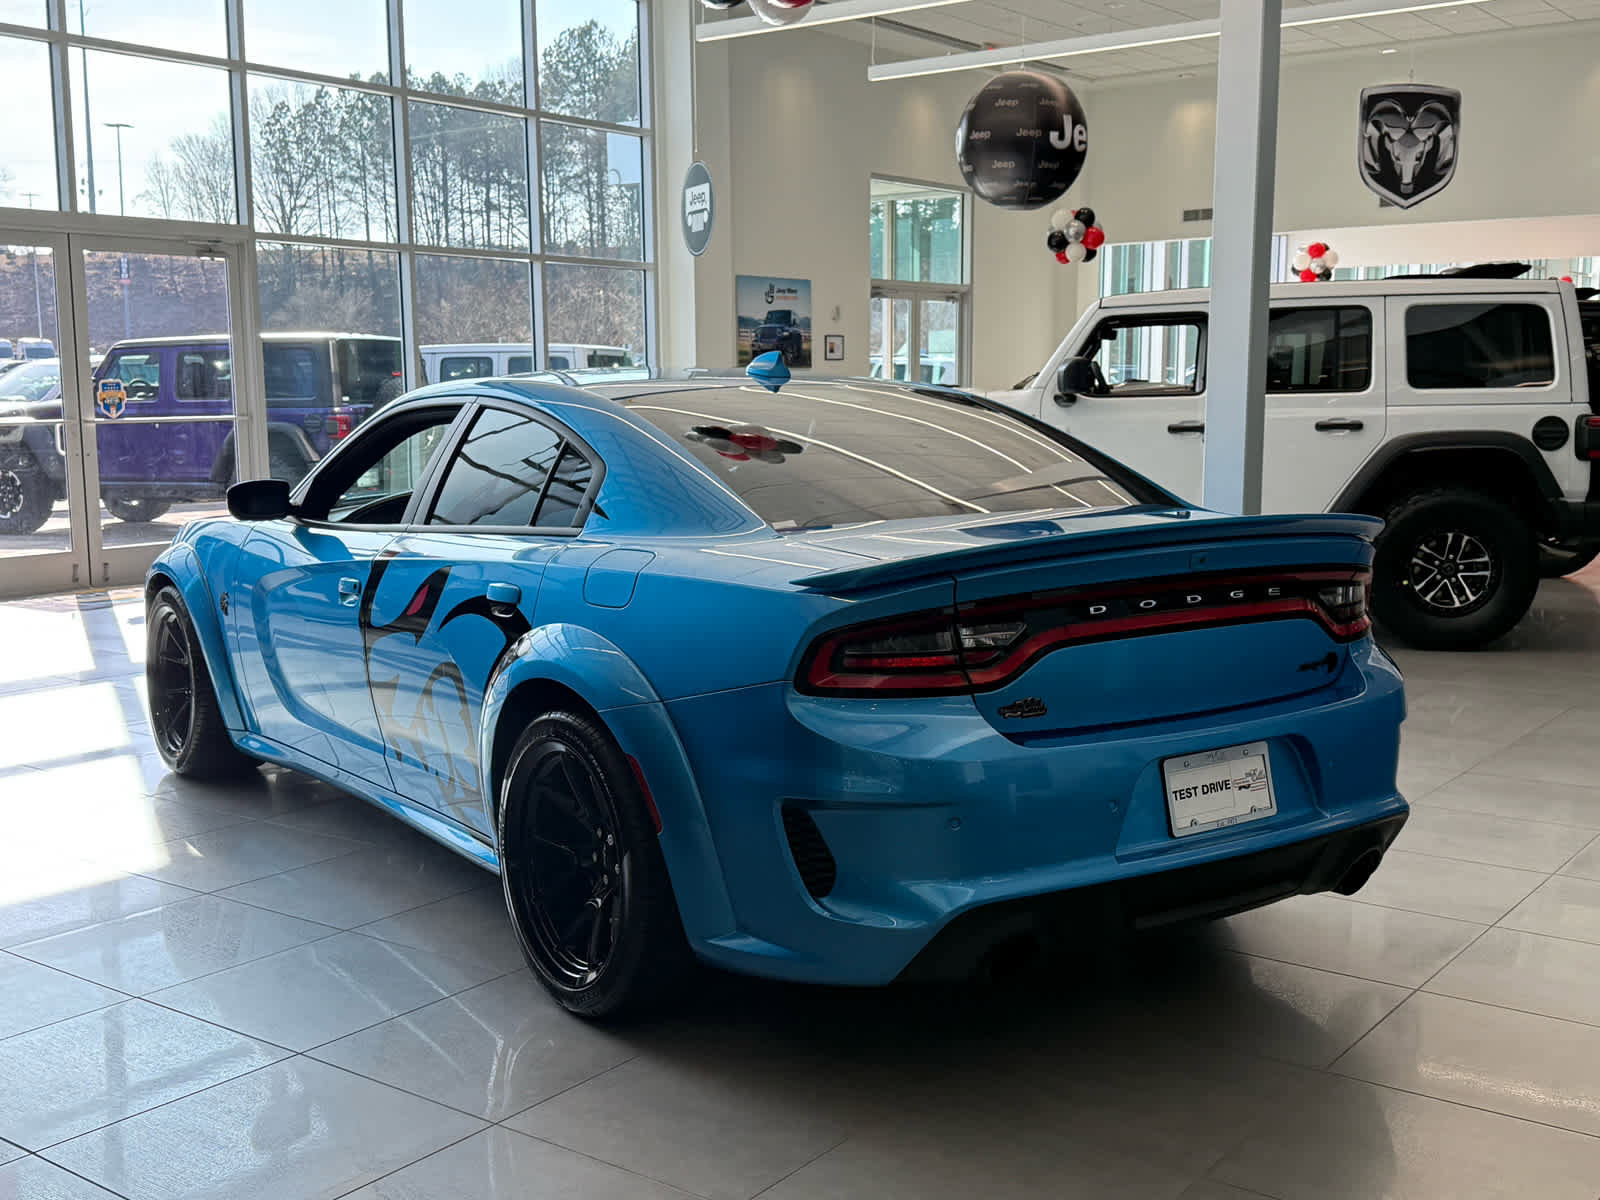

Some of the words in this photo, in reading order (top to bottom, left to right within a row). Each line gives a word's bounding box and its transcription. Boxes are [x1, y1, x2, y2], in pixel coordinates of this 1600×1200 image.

[994, 98, 1018, 107] Jeep
[969, 130, 991, 140] Jeep
[1016, 128, 1042, 138] Jeep
[992, 160, 1015, 168] Jeep
[1089, 587, 1281, 615] DODGE
[1172, 786, 1199, 801] TEST
[1201, 779, 1232, 795] DRIVE
